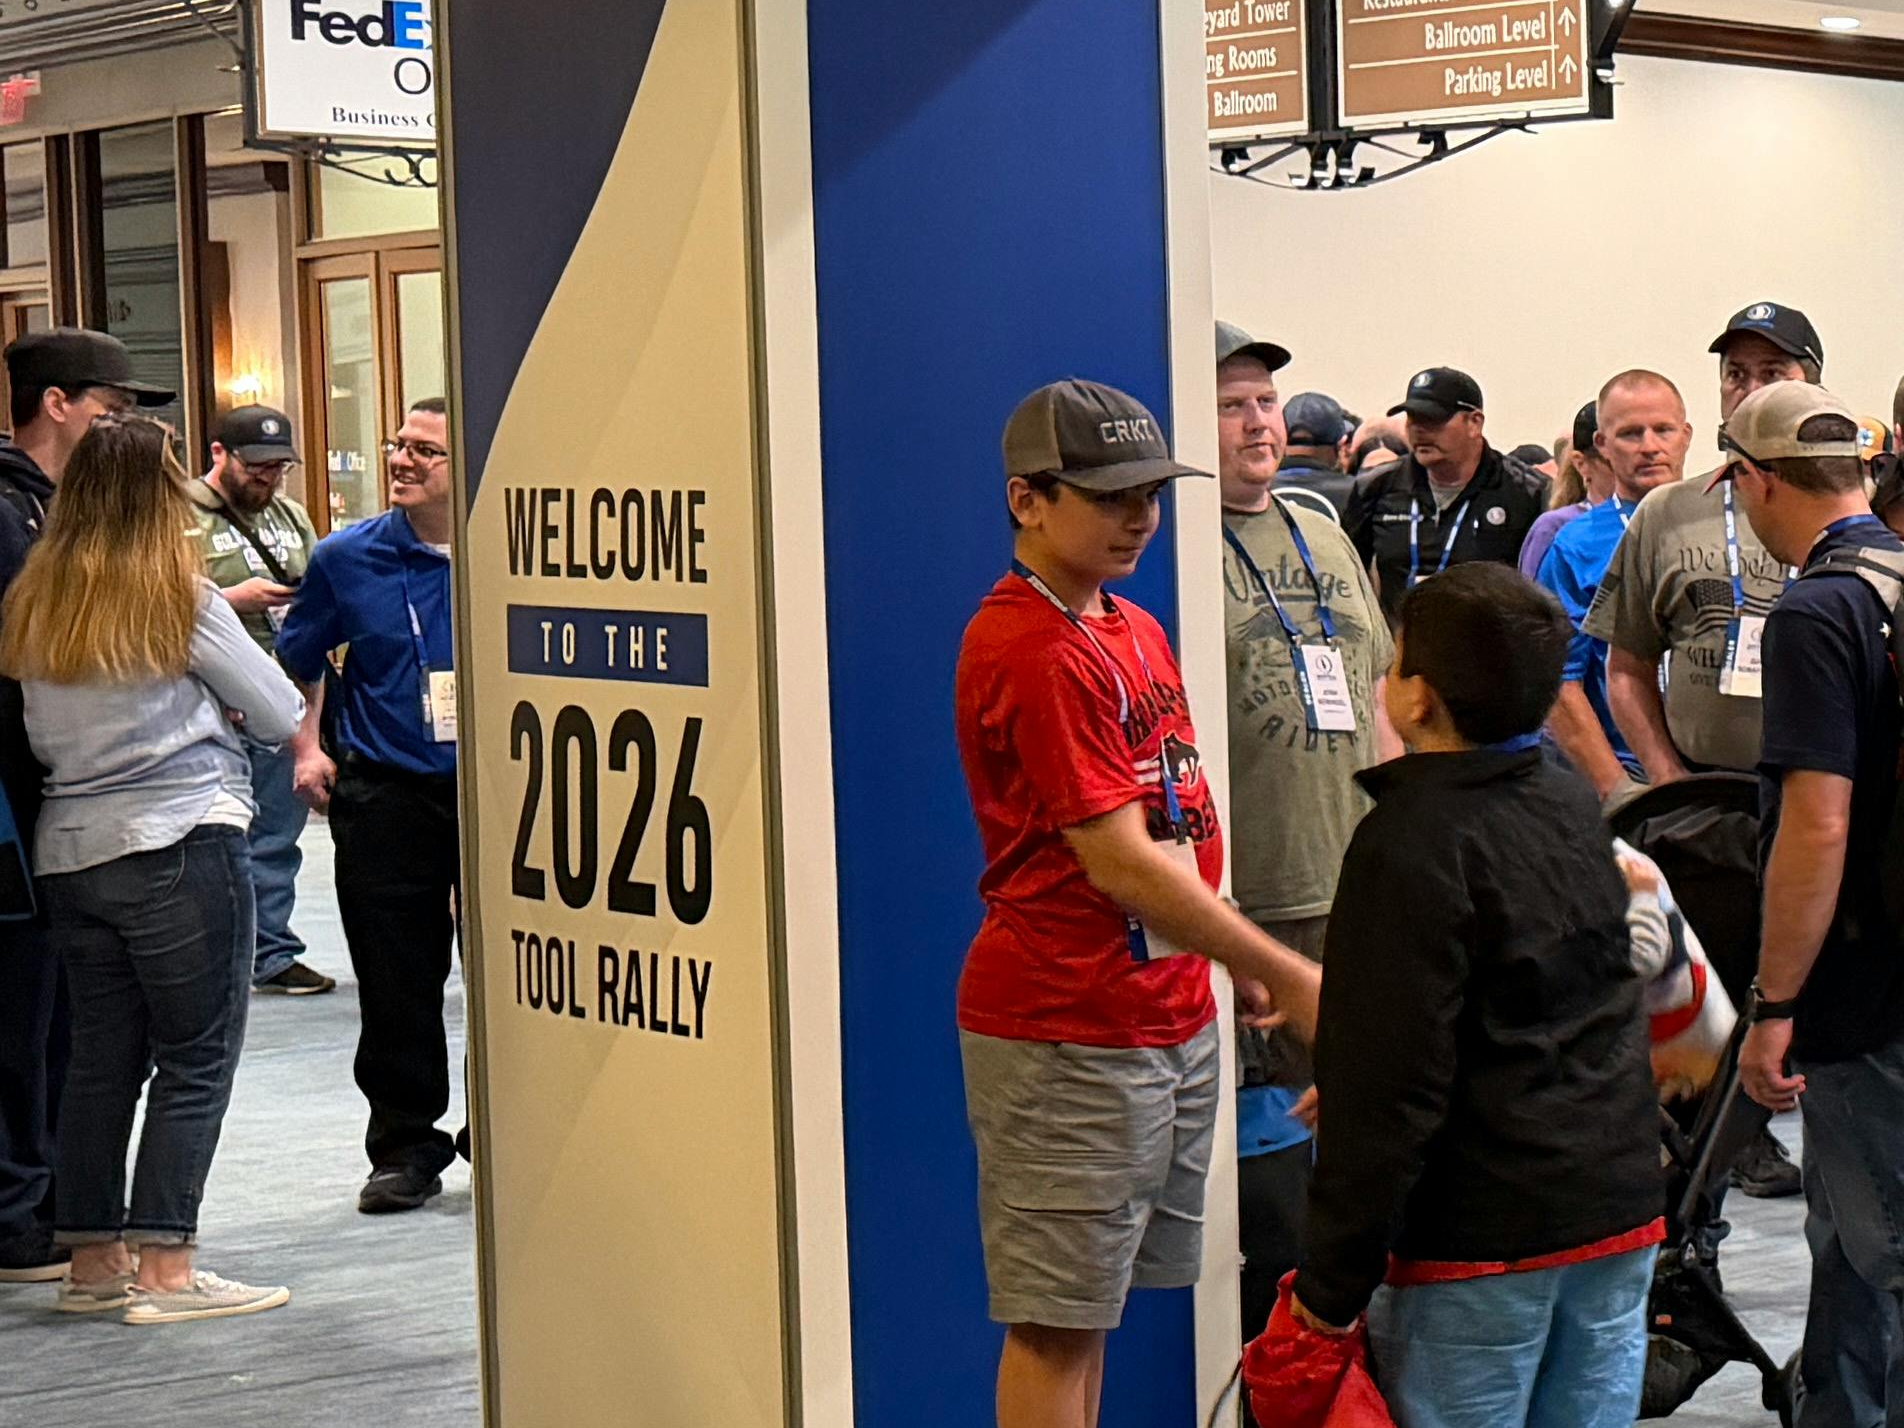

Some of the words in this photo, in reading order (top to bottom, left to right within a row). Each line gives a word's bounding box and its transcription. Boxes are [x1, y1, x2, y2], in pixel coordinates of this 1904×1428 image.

[1425, 20, 1496, 50] Ballroom
[1502, 11, 1547, 43] Level
[1228, 45, 1277, 72] Rooms
[1444, 64, 1502, 97] Parking
[1506, 59, 1548, 91] Level
[332, 106, 419, 128] Business
[1213, 90, 1278, 117] Ballroom
[505, 487, 708, 584] WELCOME
[540, 621, 576, 665] TO
[604, 624, 669, 671] THE
[511, 700, 712, 925] 2026
[511, 929, 586, 1020] TOOL
[597, 944, 712, 1040] RALLY
